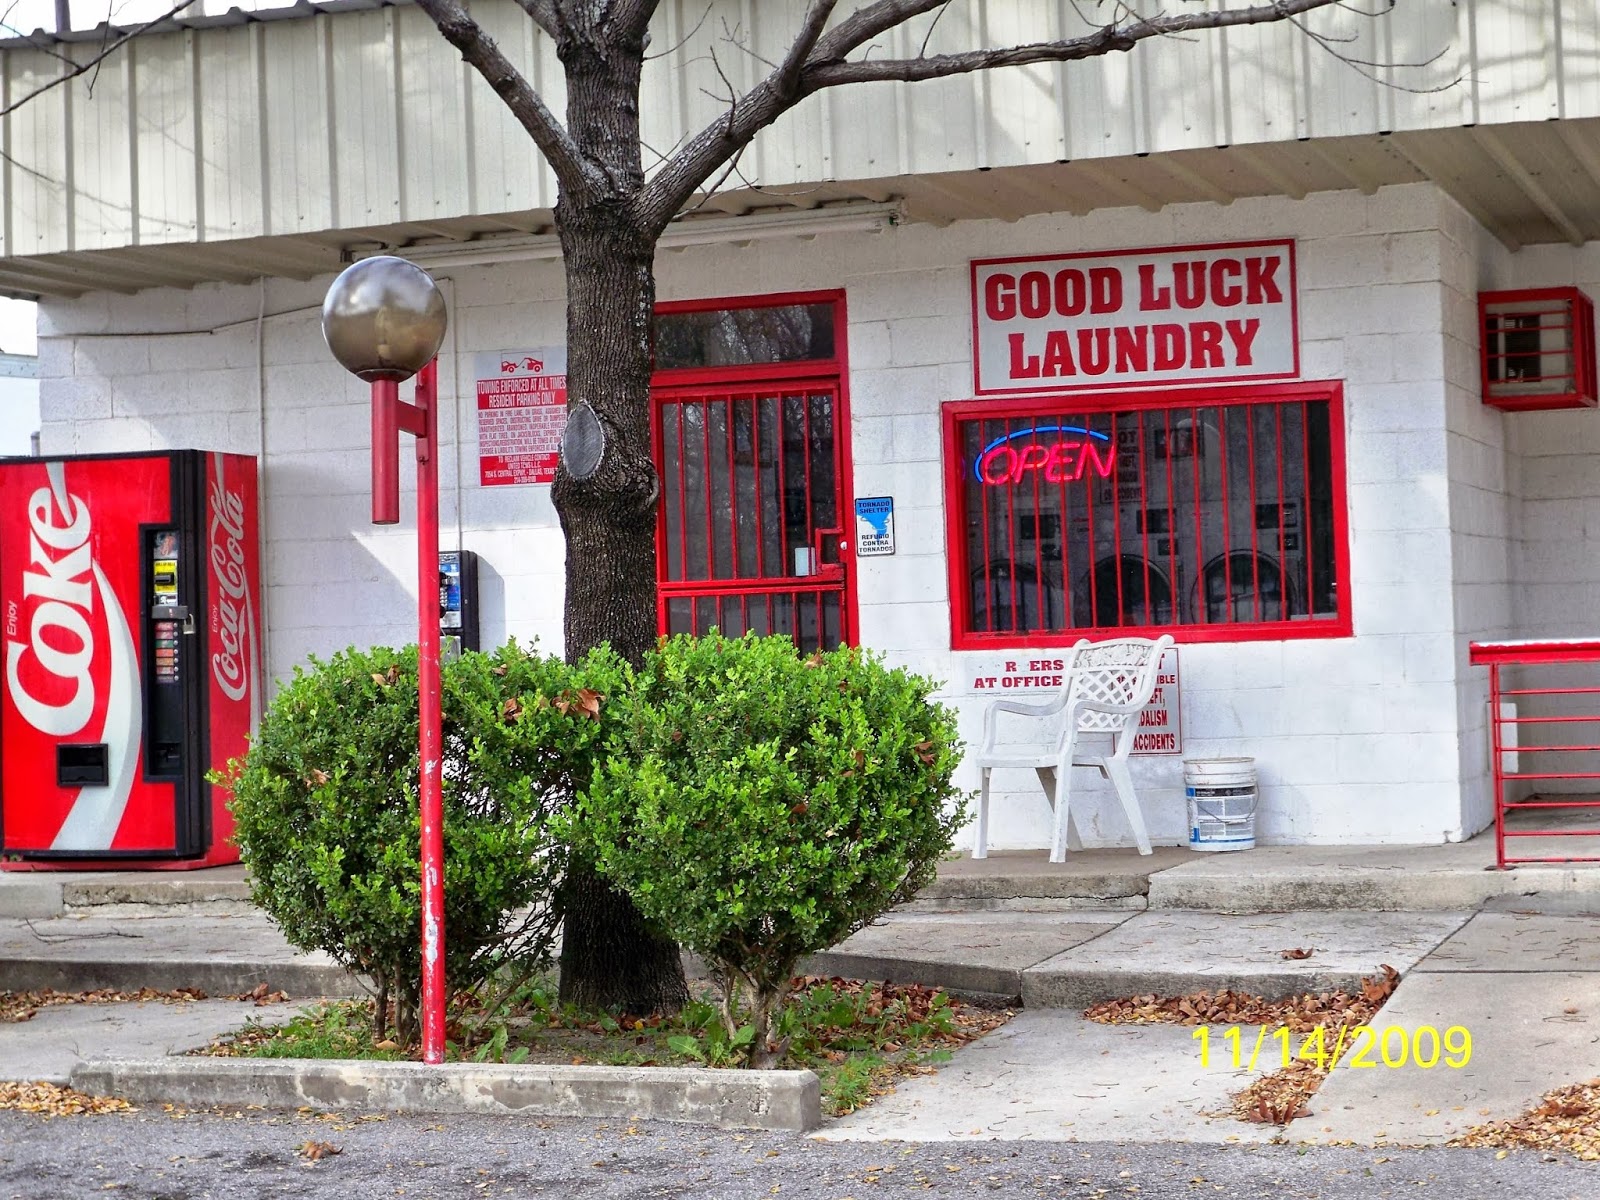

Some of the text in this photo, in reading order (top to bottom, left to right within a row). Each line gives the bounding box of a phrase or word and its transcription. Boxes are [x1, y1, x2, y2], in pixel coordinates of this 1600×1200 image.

[985, 255, 1283, 321] GOOD LUCK
[1008, 318, 1260, 379] LAUNDRY
[478, 376, 567, 395] TOWING ENFORCED AT ALL TIMES
[489, 391, 556, 408] RESIDENT PARKING ONLY
[982, 442, 1117, 485] OPEN
[859, 545, 893, 553] TORNADOS
[211, 479, 247, 701] Coca-Cola
[7, 486, 95, 736] Coke
[7, 599, 18, 637] Enjoy
[974, 675, 1063, 688] AT OFFICE
[1139, 709, 1168, 727] DALISM
[1133, 733, 1175, 751] ACCIDENTS
